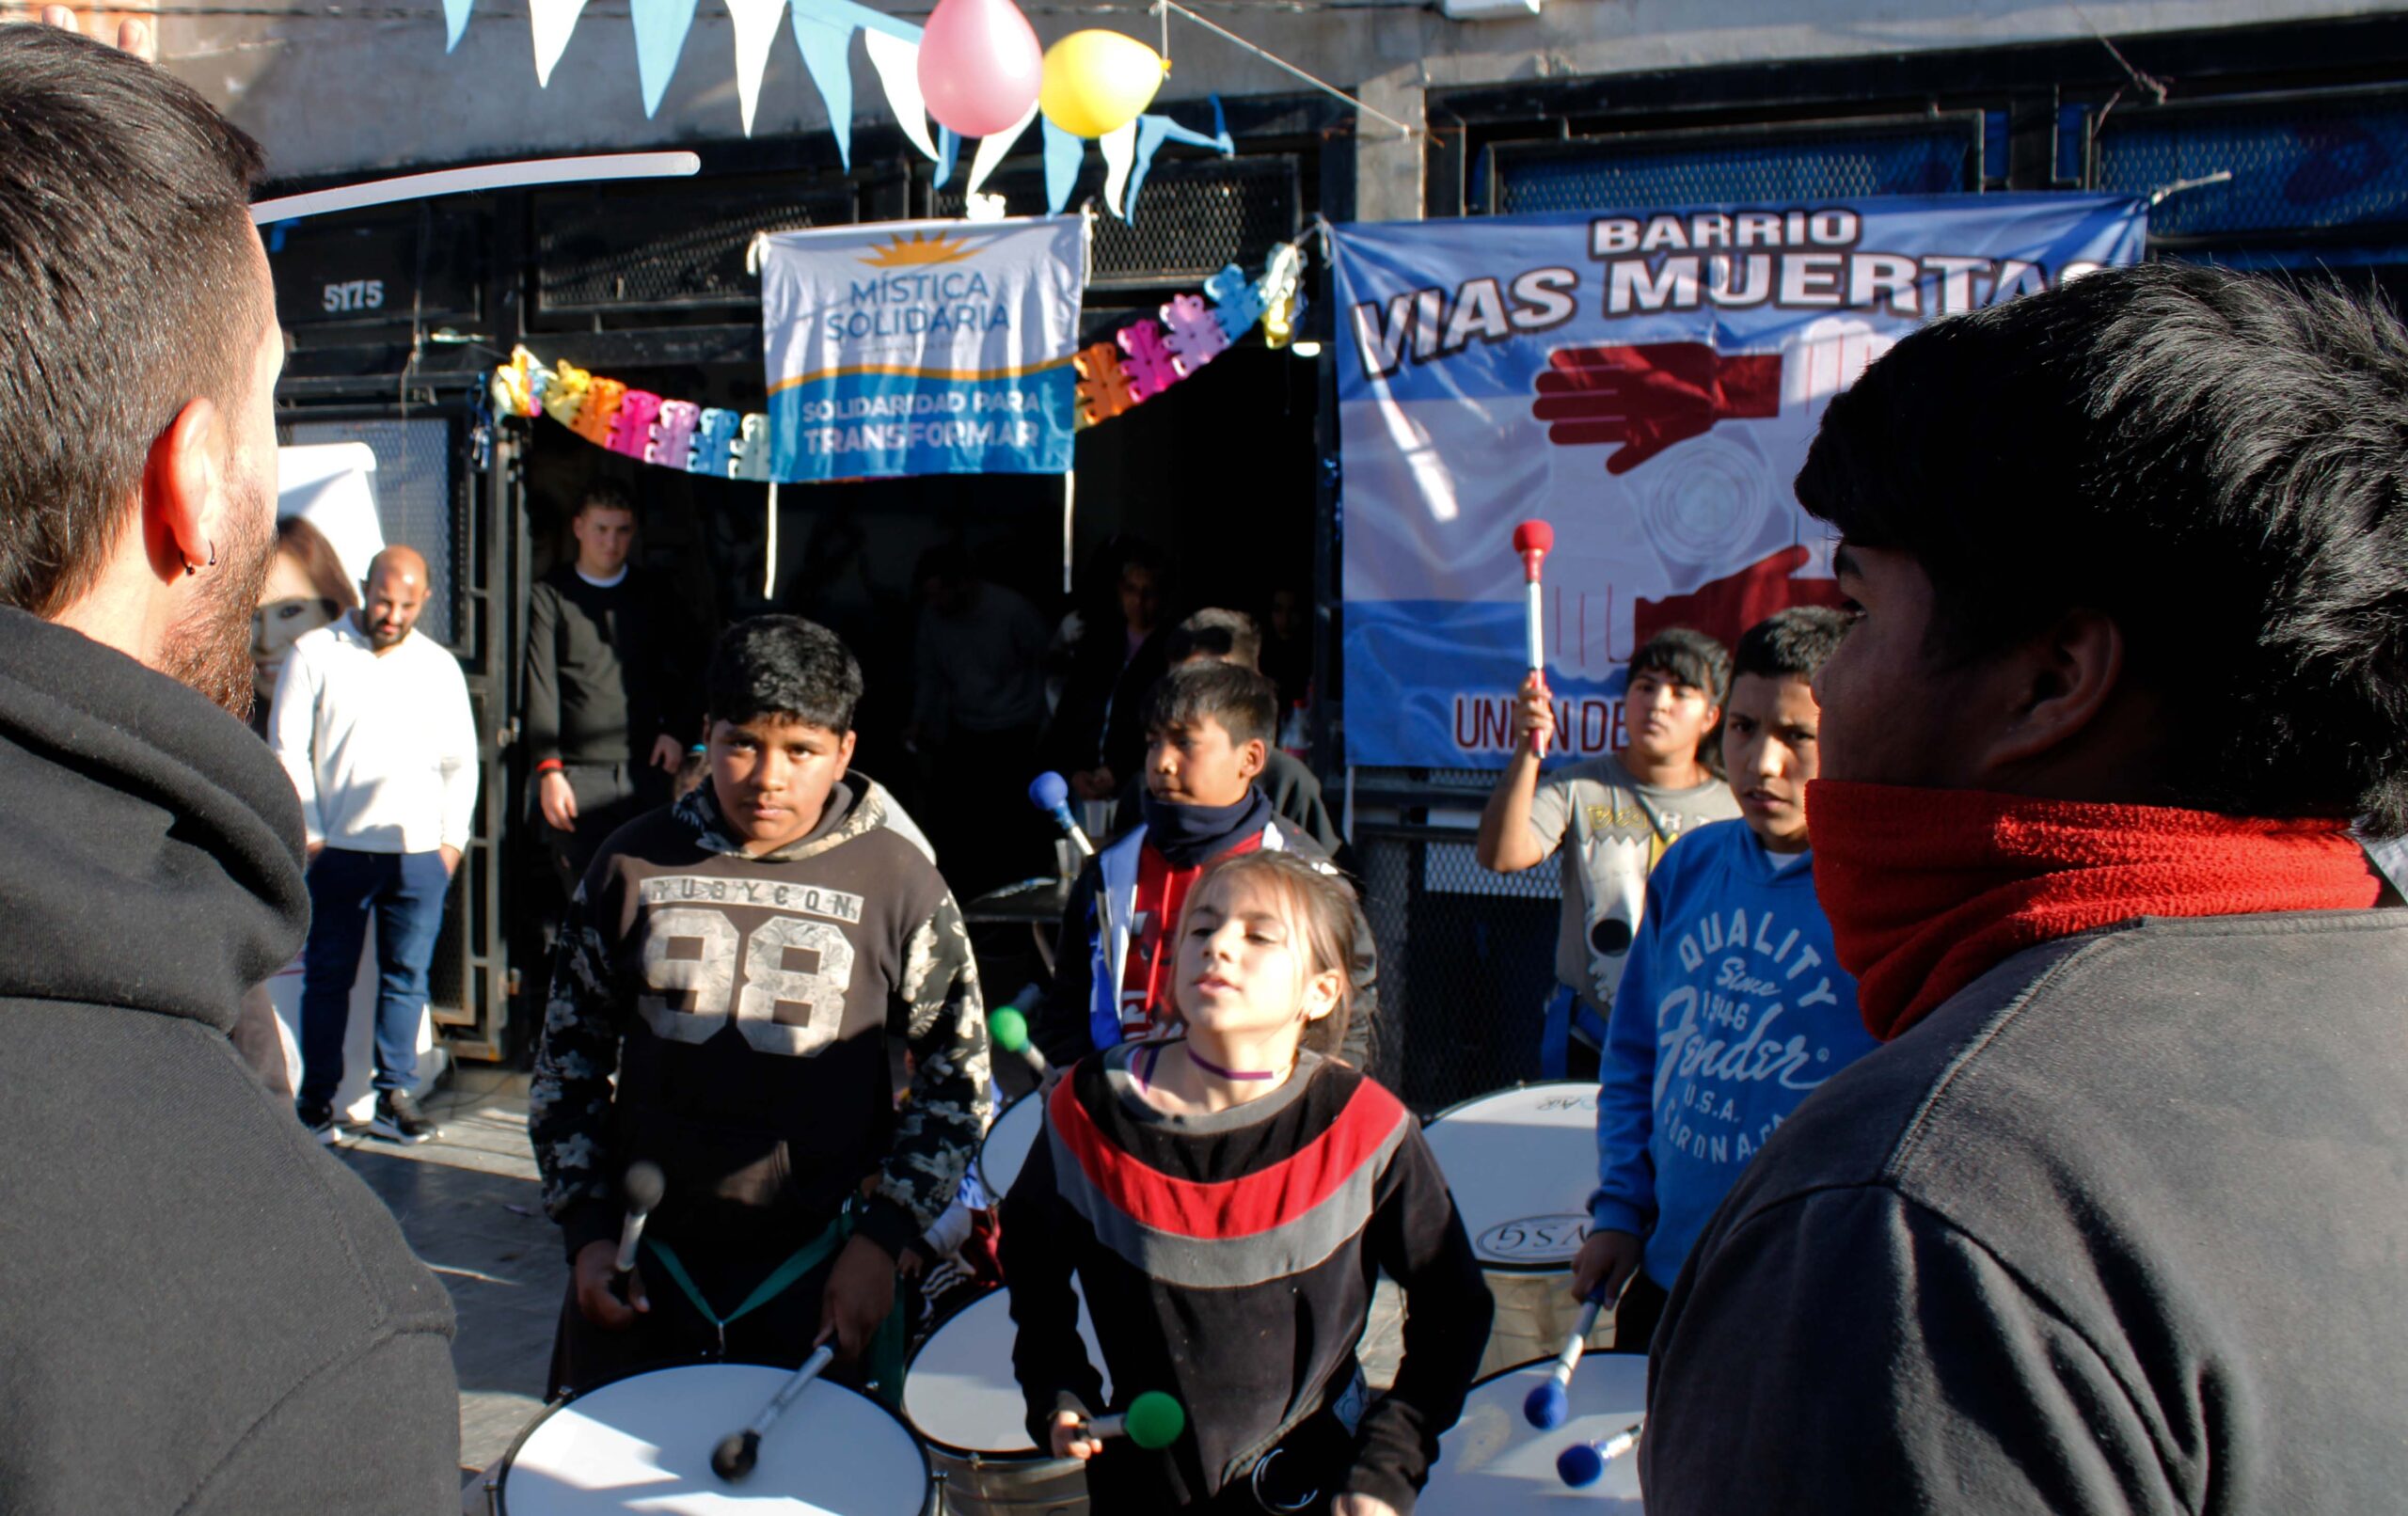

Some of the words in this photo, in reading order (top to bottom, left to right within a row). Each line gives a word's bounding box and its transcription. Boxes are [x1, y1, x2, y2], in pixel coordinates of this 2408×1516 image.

[1592, 209, 1858, 255] BARRIO
[324, 280, 384, 312] 5175
[850, 271, 990, 305] MÍSTICA
[825, 304, 1010, 341] SOLIDARIA
[1354, 267, 1576, 373] VIAS
[1608, 251, 2099, 313] MUERTA
[802, 391, 965, 422] SOLIDARIDAD
[973, 391, 1040, 415] PARA
[803, 421, 1039, 454] TRANSFORMAR
[1456, 697, 1569, 751] UNIN
[1678, 908, 1837, 1007] QUALITY
[1715, 955, 1782, 997] Since
[638, 908, 855, 1058] 98
[1702, 990, 1751, 1031] 1946
[1653, 985, 1823, 1113] Fender
[1684, 1083, 1742, 1124] U.S.A.
